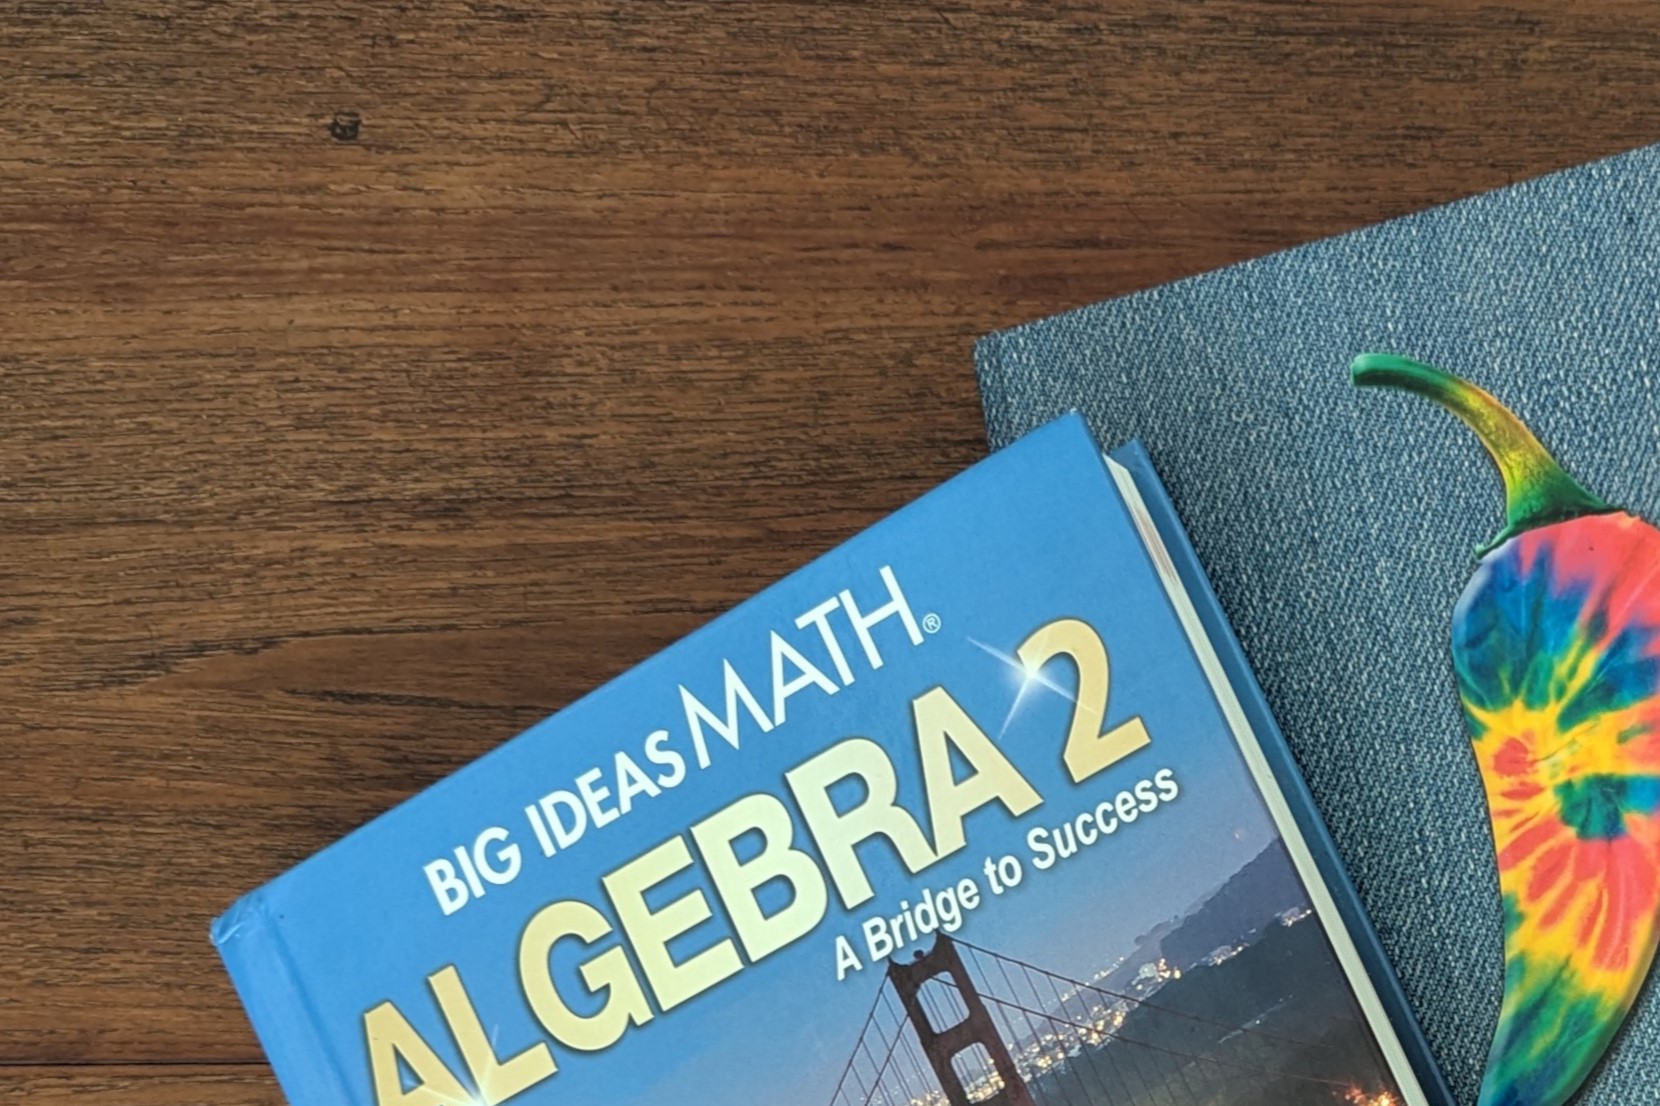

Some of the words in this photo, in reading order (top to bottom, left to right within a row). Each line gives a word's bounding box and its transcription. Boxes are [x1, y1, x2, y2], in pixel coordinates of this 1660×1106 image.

[1015, 618, 1151, 783] 2
[422, 826, 523, 917] BIG
[524, 730, 687, 858] IDEAS
[833, 935, 863, 981] A
[861, 877, 981, 962] Bridge
[983, 855, 1023, 895] to
[1026, 768, 1179, 870] Success
